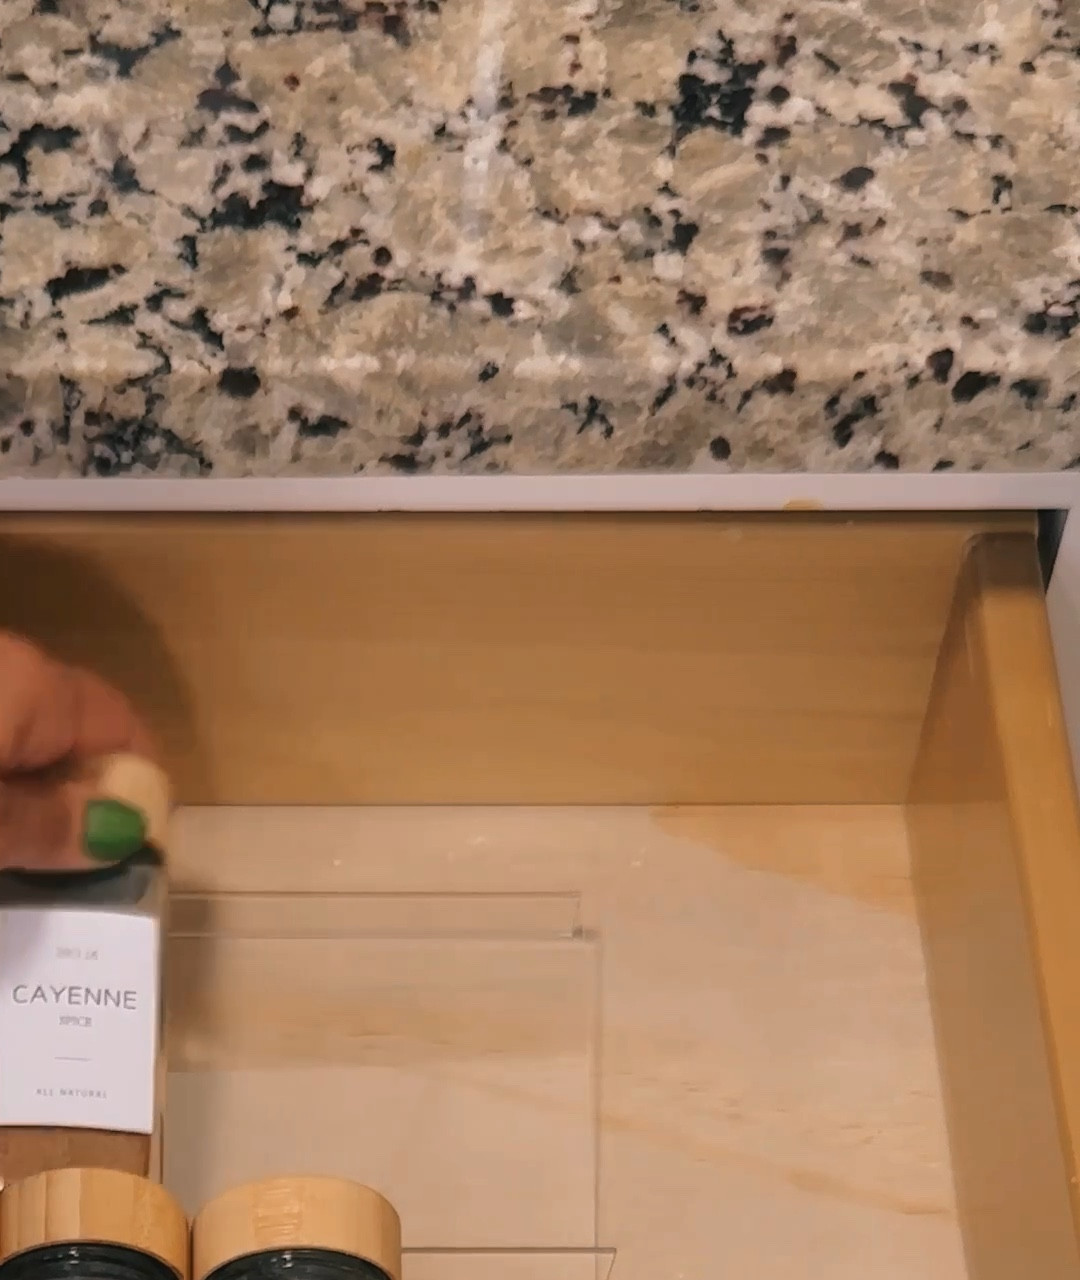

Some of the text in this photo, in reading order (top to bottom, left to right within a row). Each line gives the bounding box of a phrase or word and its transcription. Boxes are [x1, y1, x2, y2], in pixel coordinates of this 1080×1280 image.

[13, 984, 136, 1009] CAYENNE
[37, 1089, 107, 1099] ALL NATURAL
